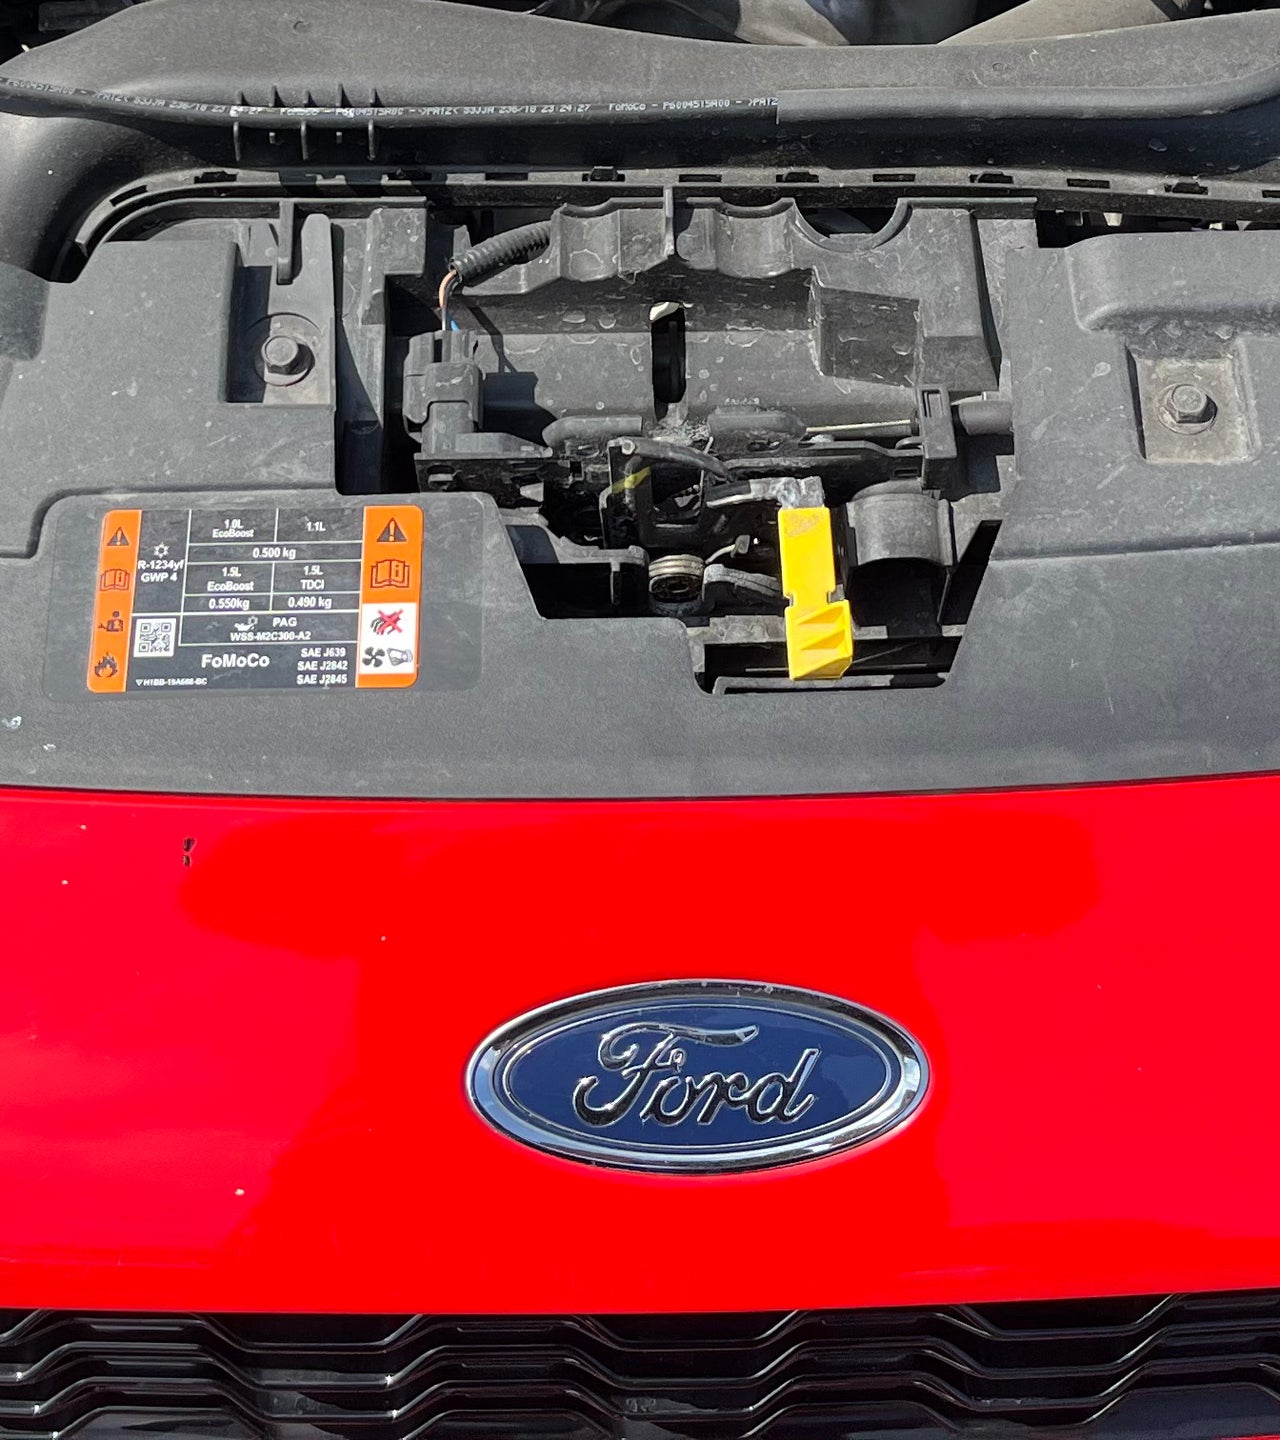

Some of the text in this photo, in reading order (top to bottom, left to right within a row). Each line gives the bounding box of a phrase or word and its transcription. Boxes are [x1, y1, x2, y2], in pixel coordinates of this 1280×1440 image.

[609, 101, 646, 112] FoMoCo
[223, 519, 244, 530] 1.0L
[306, 521, 326, 532] 1.1L
[212, 528, 254, 538] EcoBoost
[252, 547, 296, 560] 0.500 kg
[137, 559, 184, 571] R-1234yf
[303, 565, 323, 576] 1.5L
[141, 572, 177, 583] GWP 4
[222, 567, 242, 578] 1.5L
[207, 581, 254, 592] EcoBoost
[208, 598, 250, 611] 0.550kg
[288, 596, 332, 610] 0.490 kg
[272, 617, 297, 628] PAG
[230, 631, 312, 642] WSS-M2C300-A2
[301, 647, 346, 657] SAE J639
[201, 653, 271, 669] FoMoCo
[297, 660, 348, 671] SAE J2842
[296, 674, 348, 685] SAE J2845
[573, 1021, 820, 1127] Ford
